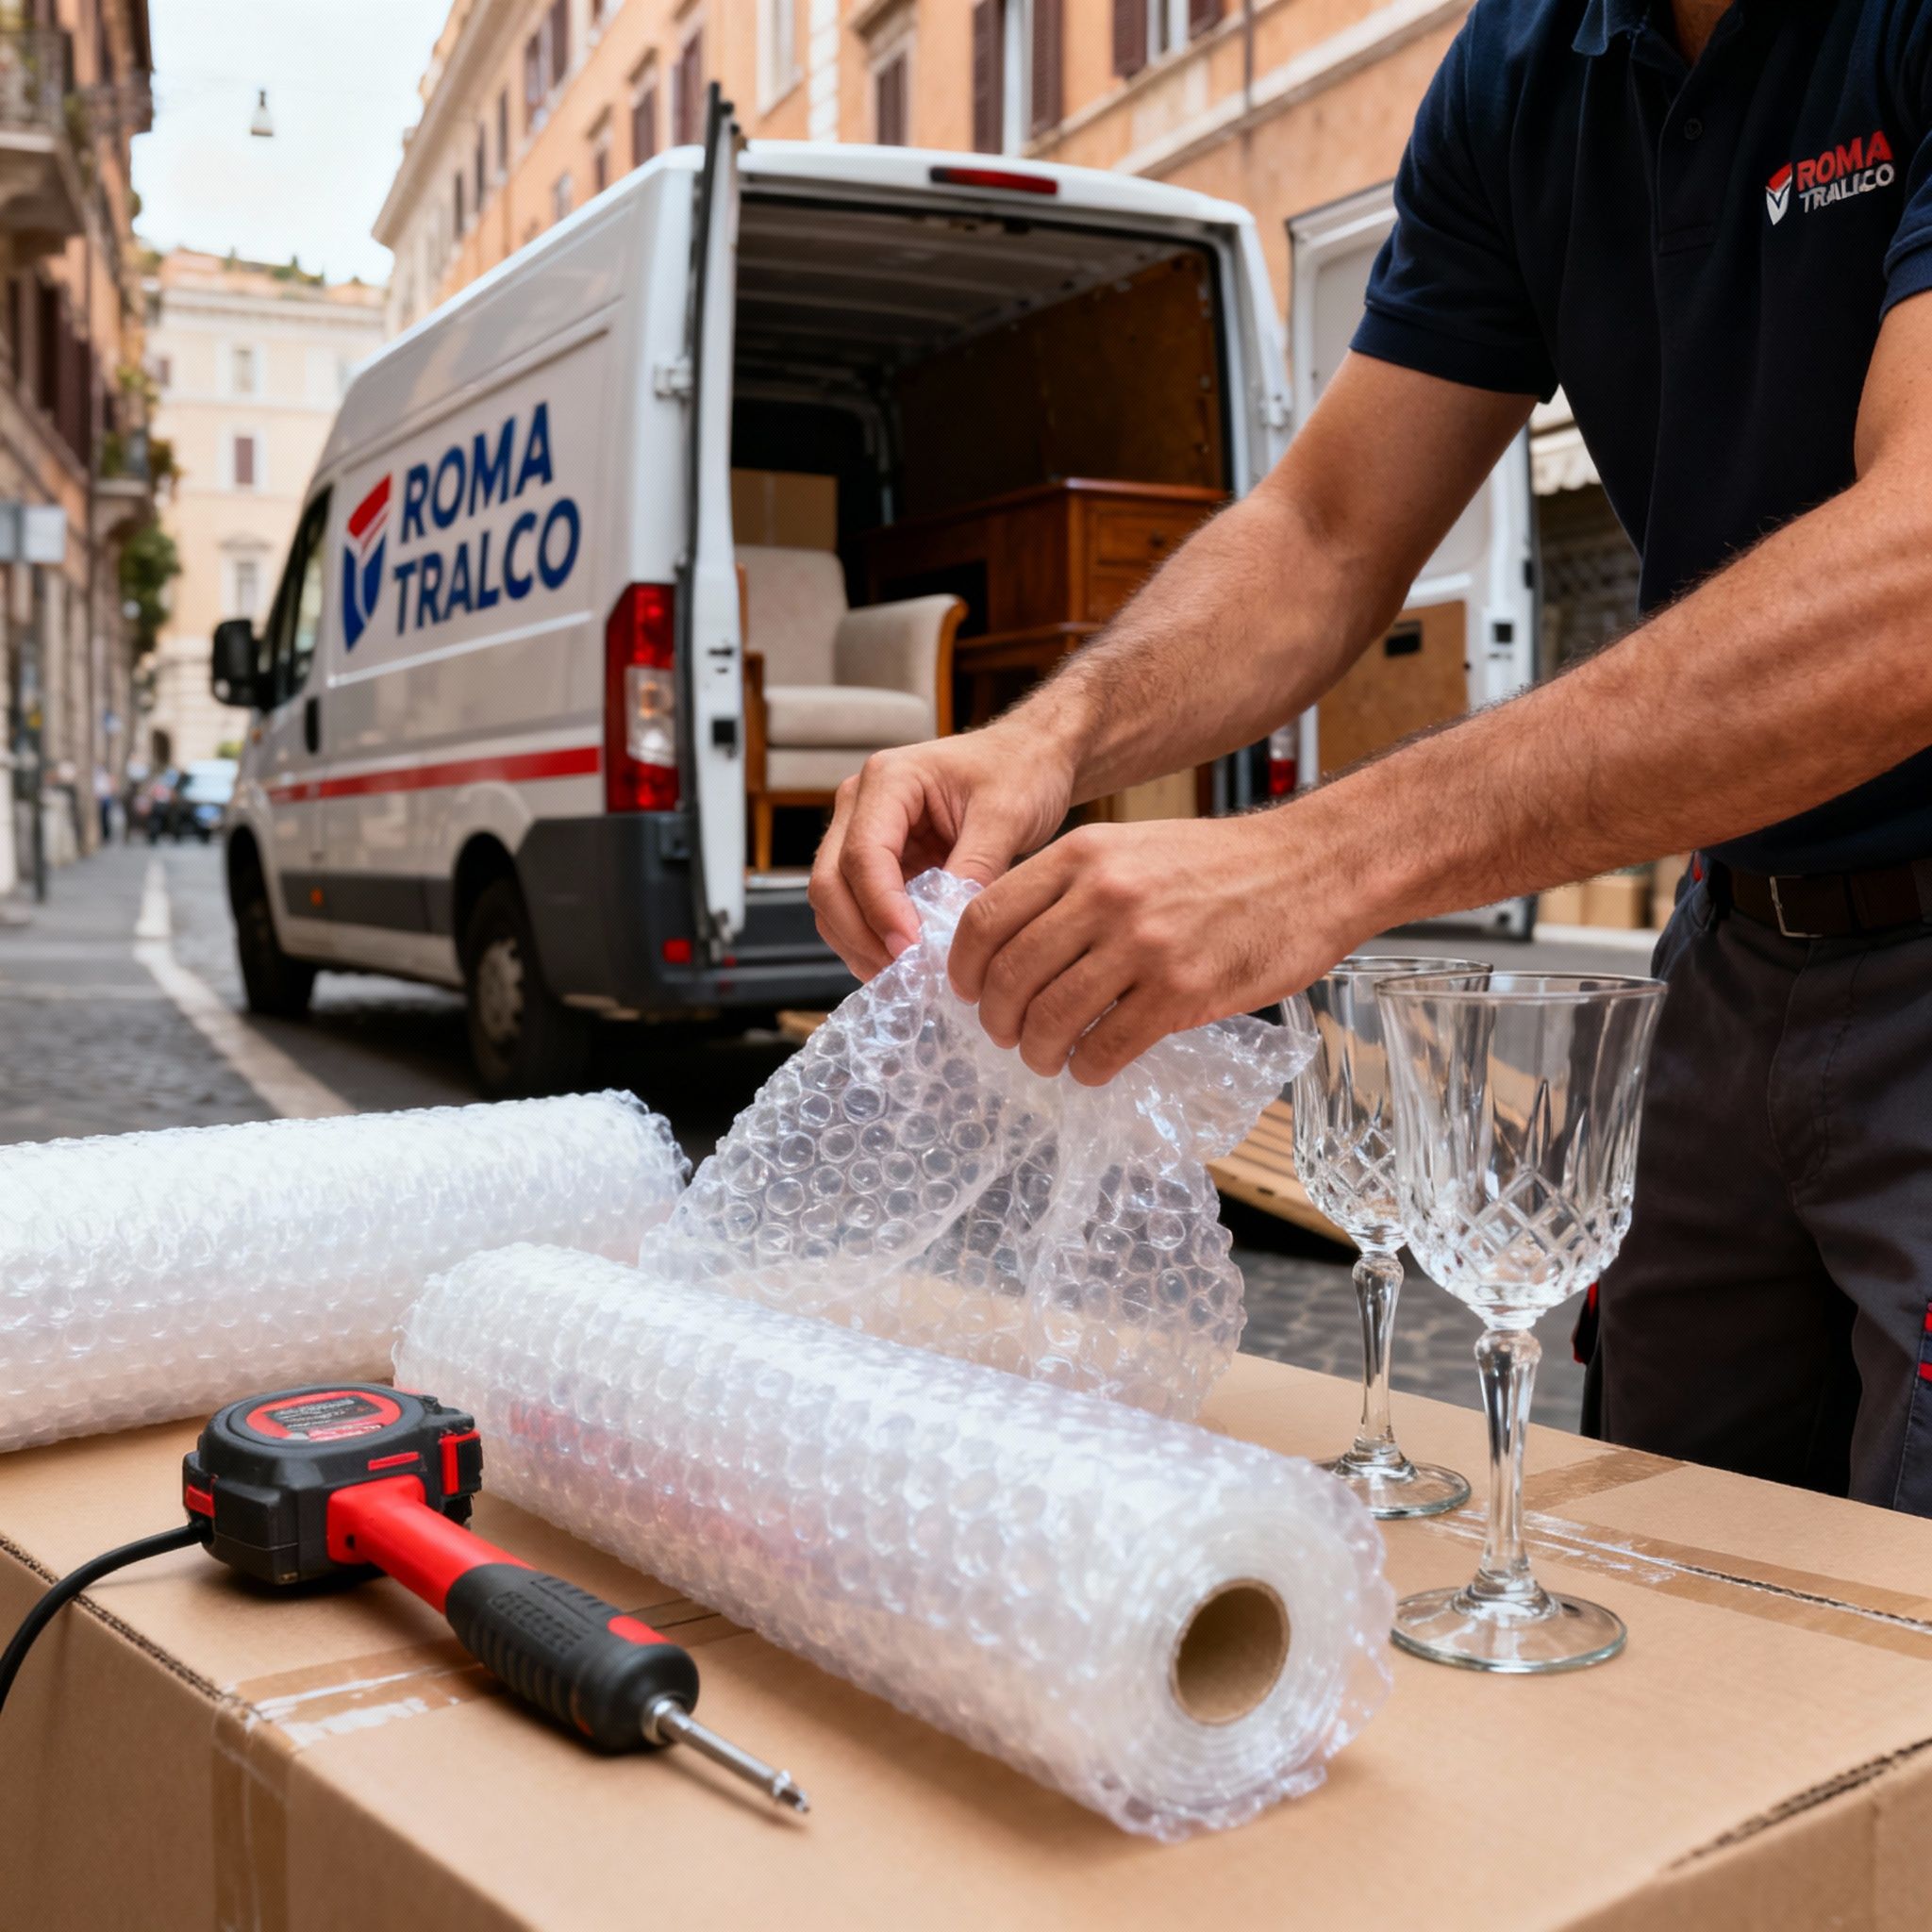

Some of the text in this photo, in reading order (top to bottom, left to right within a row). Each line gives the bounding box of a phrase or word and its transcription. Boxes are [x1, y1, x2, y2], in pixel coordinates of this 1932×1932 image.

[1796, 129, 1893, 192] ROMA
[399, 400, 553, 544] ROMA
[392, 496, 581, 637] TRALCO
